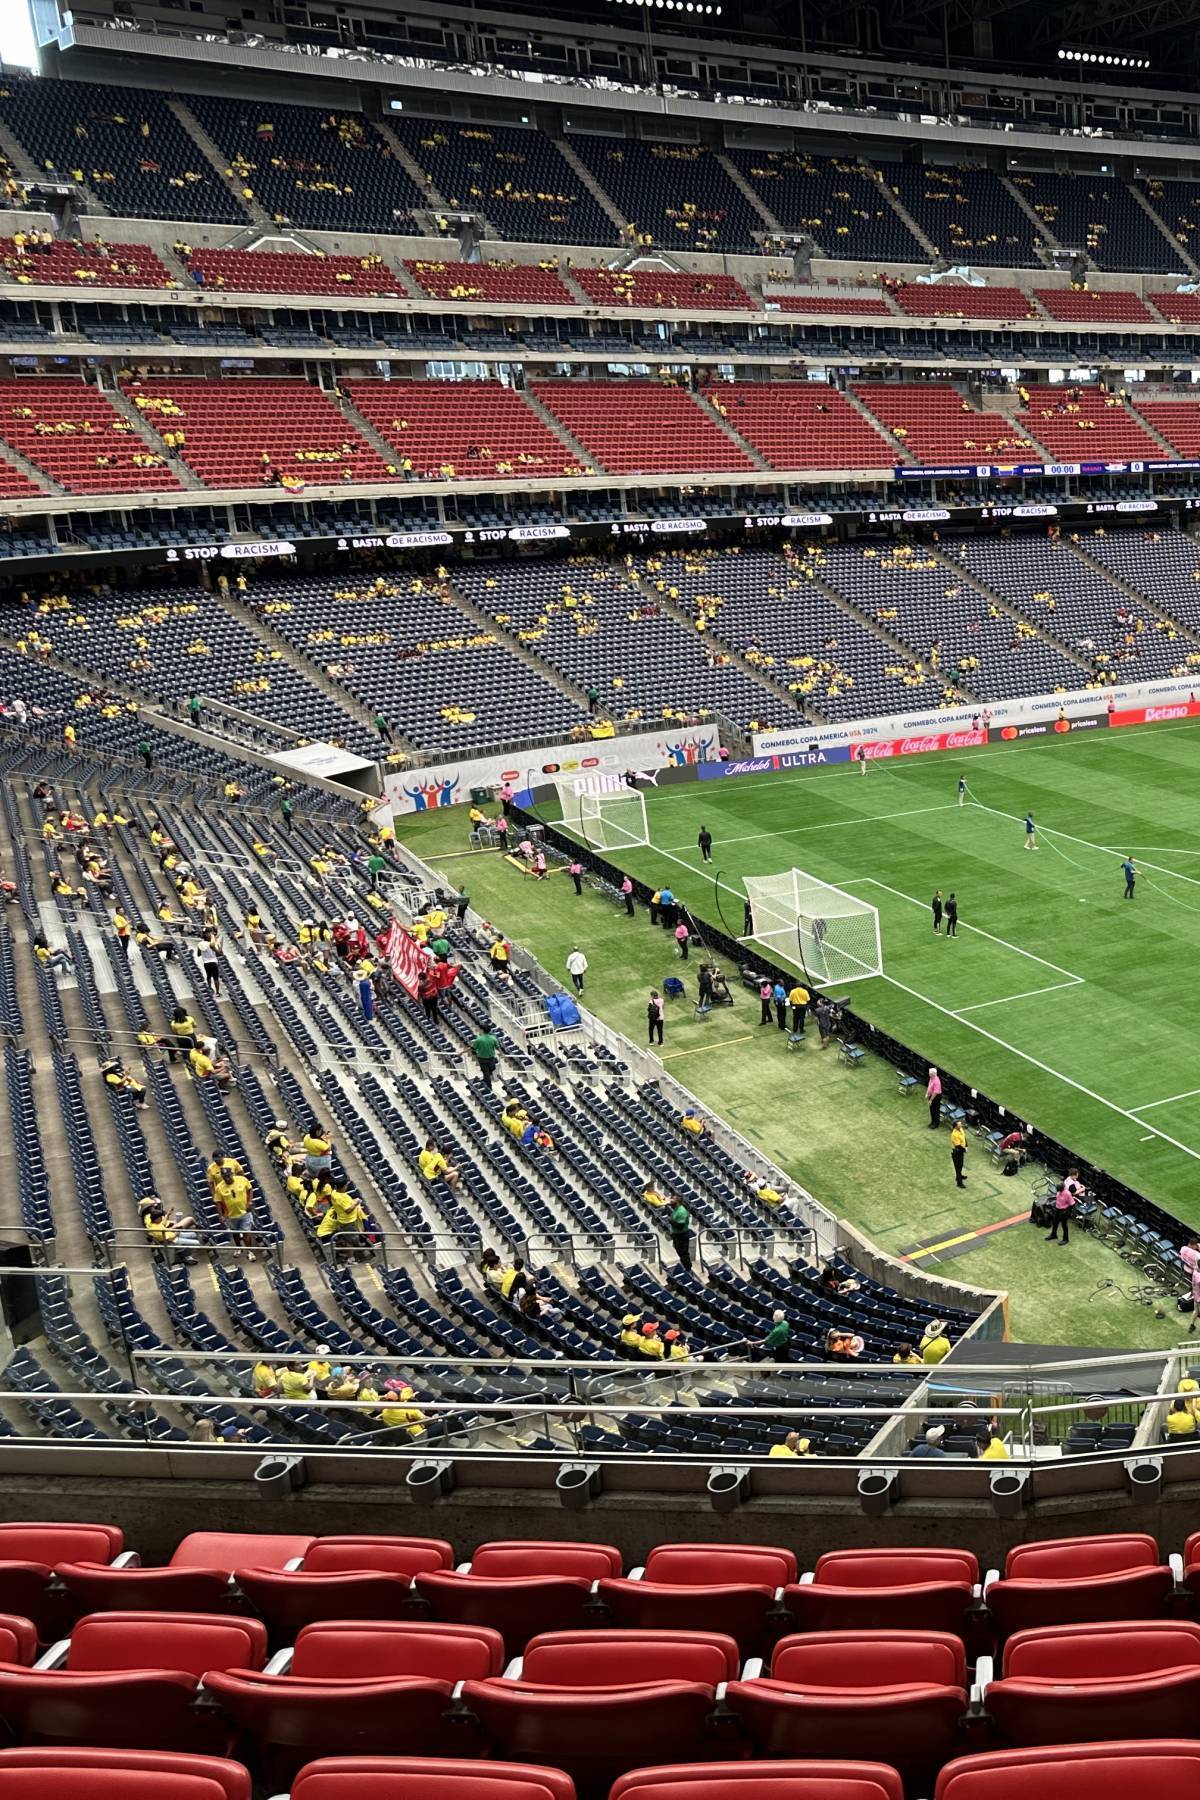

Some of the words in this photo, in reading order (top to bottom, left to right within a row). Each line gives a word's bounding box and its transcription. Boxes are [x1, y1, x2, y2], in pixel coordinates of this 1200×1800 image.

[1051, 465, 1074, 474] 00:00
[992, 508, 1011, 516] STOP
[623, 524, 649, 532] BASTA
[668, 521, 702, 529] RACISMO
[757, 518, 779, 526] STOP
[790, 516, 821, 524] RACISM
[480, 531, 507, 540] STOP
[520, 529, 556, 537] RACISM
[352, 539, 384, 548] BASTA
[392, 536, 404, 544] DE
[407, 535, 448, 543] RACISMO
[185, 547, 218, 559] STOP
[235, 544, 279, 556] RACISM
[1032, 702, 1062, 710] CONMEBOL
[1079, 696, 1102, 704] AMERICA
[1145, 705, 1188, 721] Betano
[904, 720, 937, 728] CONMEBOL
[1071, 719, 1097, 729] priceless
[1019, 726, 1046, 736] priceless
[761, 738, 799, 749] CONMEBOL
[801, 736, 818, 744] COPA
[820, 732, 848, 741] AMERICA
[725, 759, 772, 775] Michelob
[782, 752, 826, 767] ULTRA
